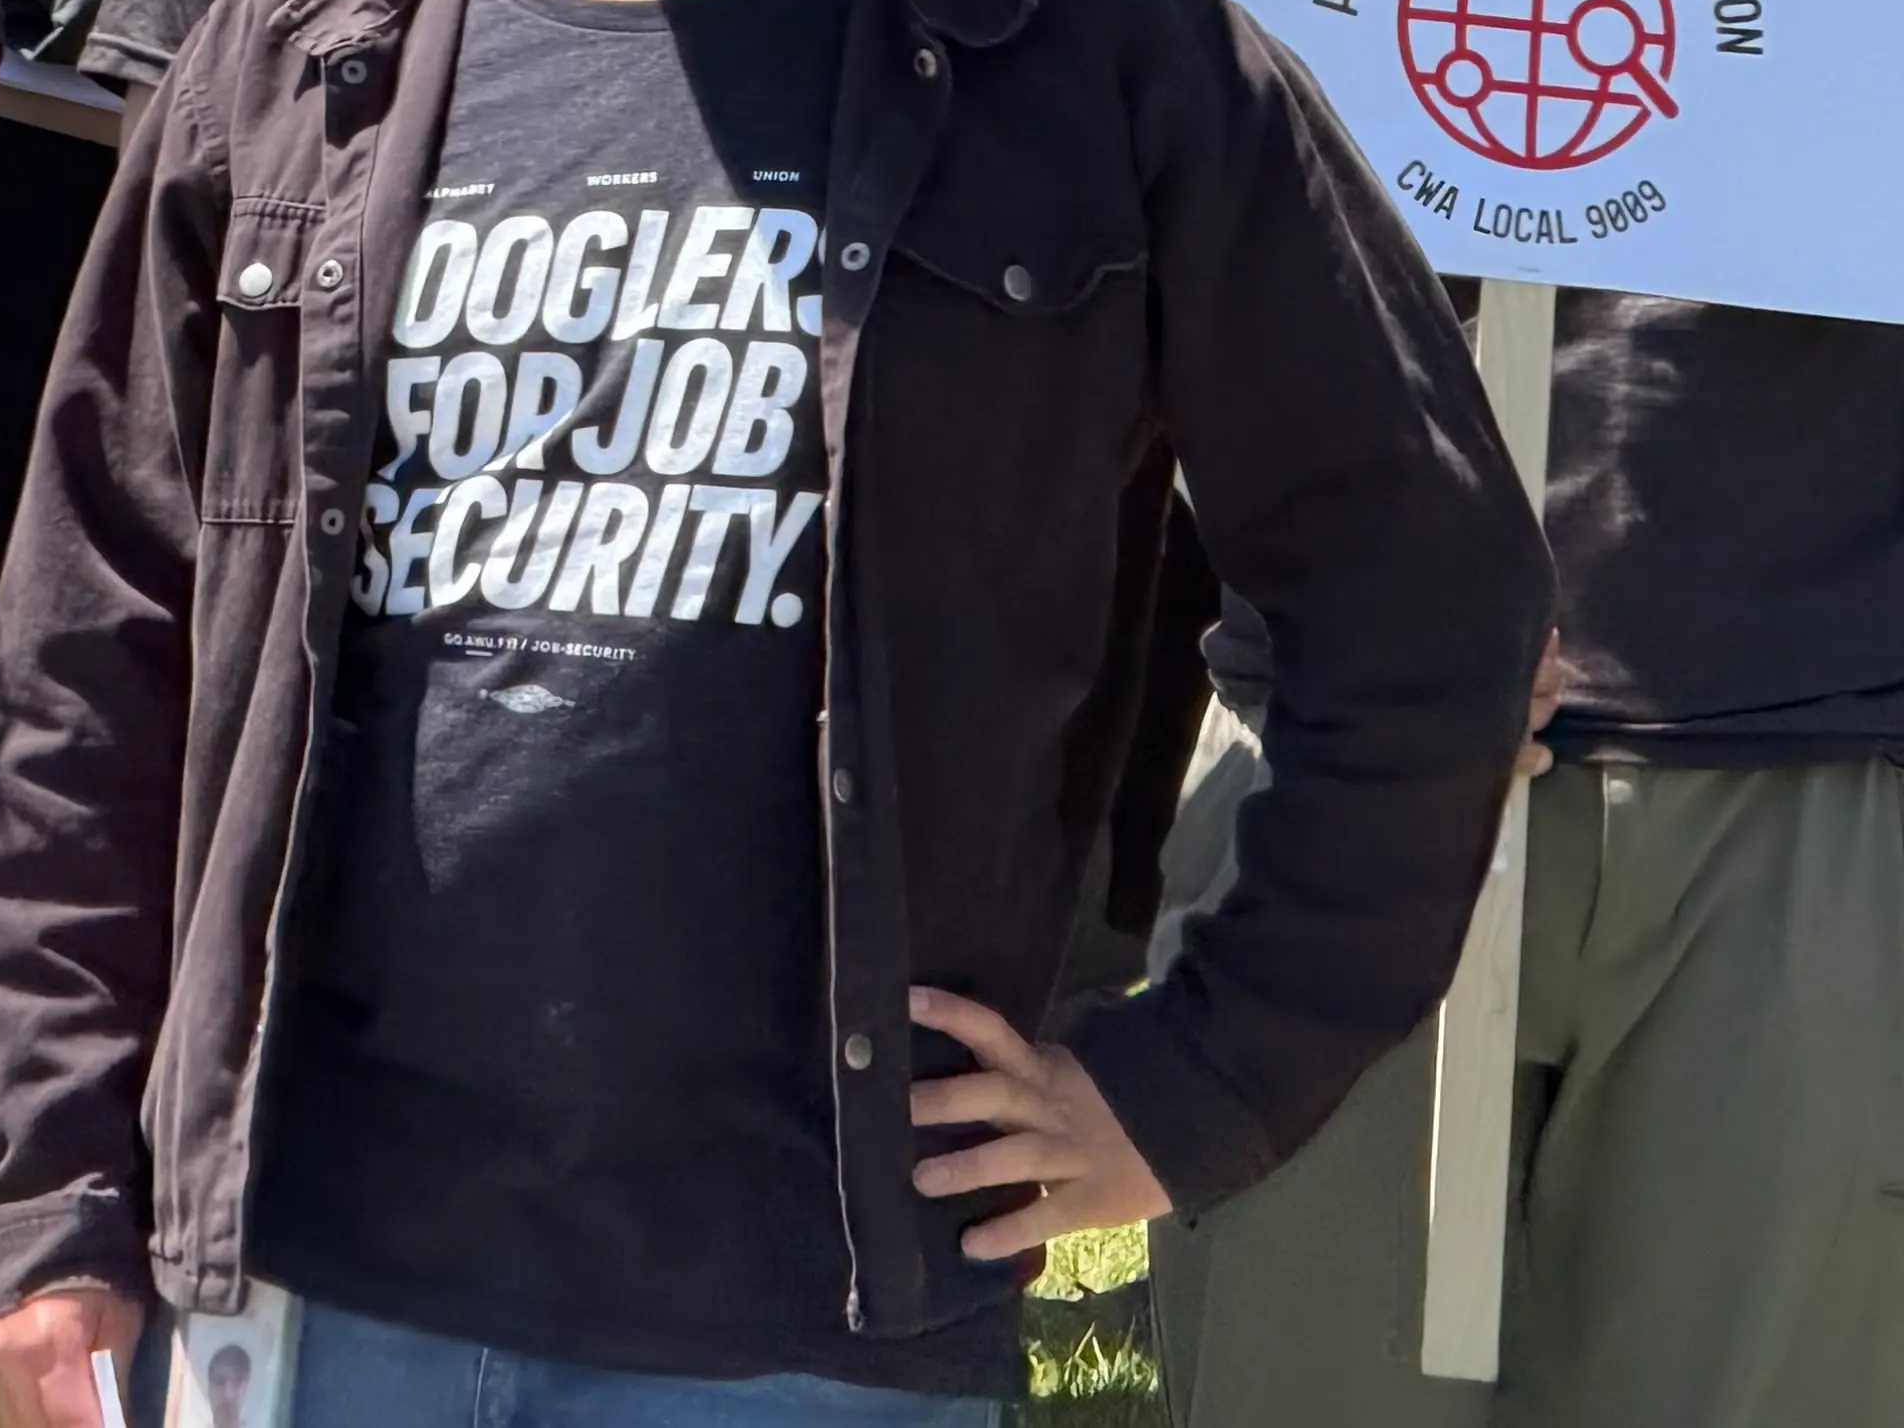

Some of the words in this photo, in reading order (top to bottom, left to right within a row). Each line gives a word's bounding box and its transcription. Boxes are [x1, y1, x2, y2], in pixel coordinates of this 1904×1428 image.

[587, 171, 658, 187] WORKERS
[752, 170, 801, 183] UNION
[1396, 159, 1458, 220] CWA
[1473, 197, 1579, 245] LOCAL
[1586, 179, 1668, 241] 9009
[383, 351, 584, 482] FOR
[571, 338, 808, 477] JOB
[351, 474, 824, 629] SECURITY.
